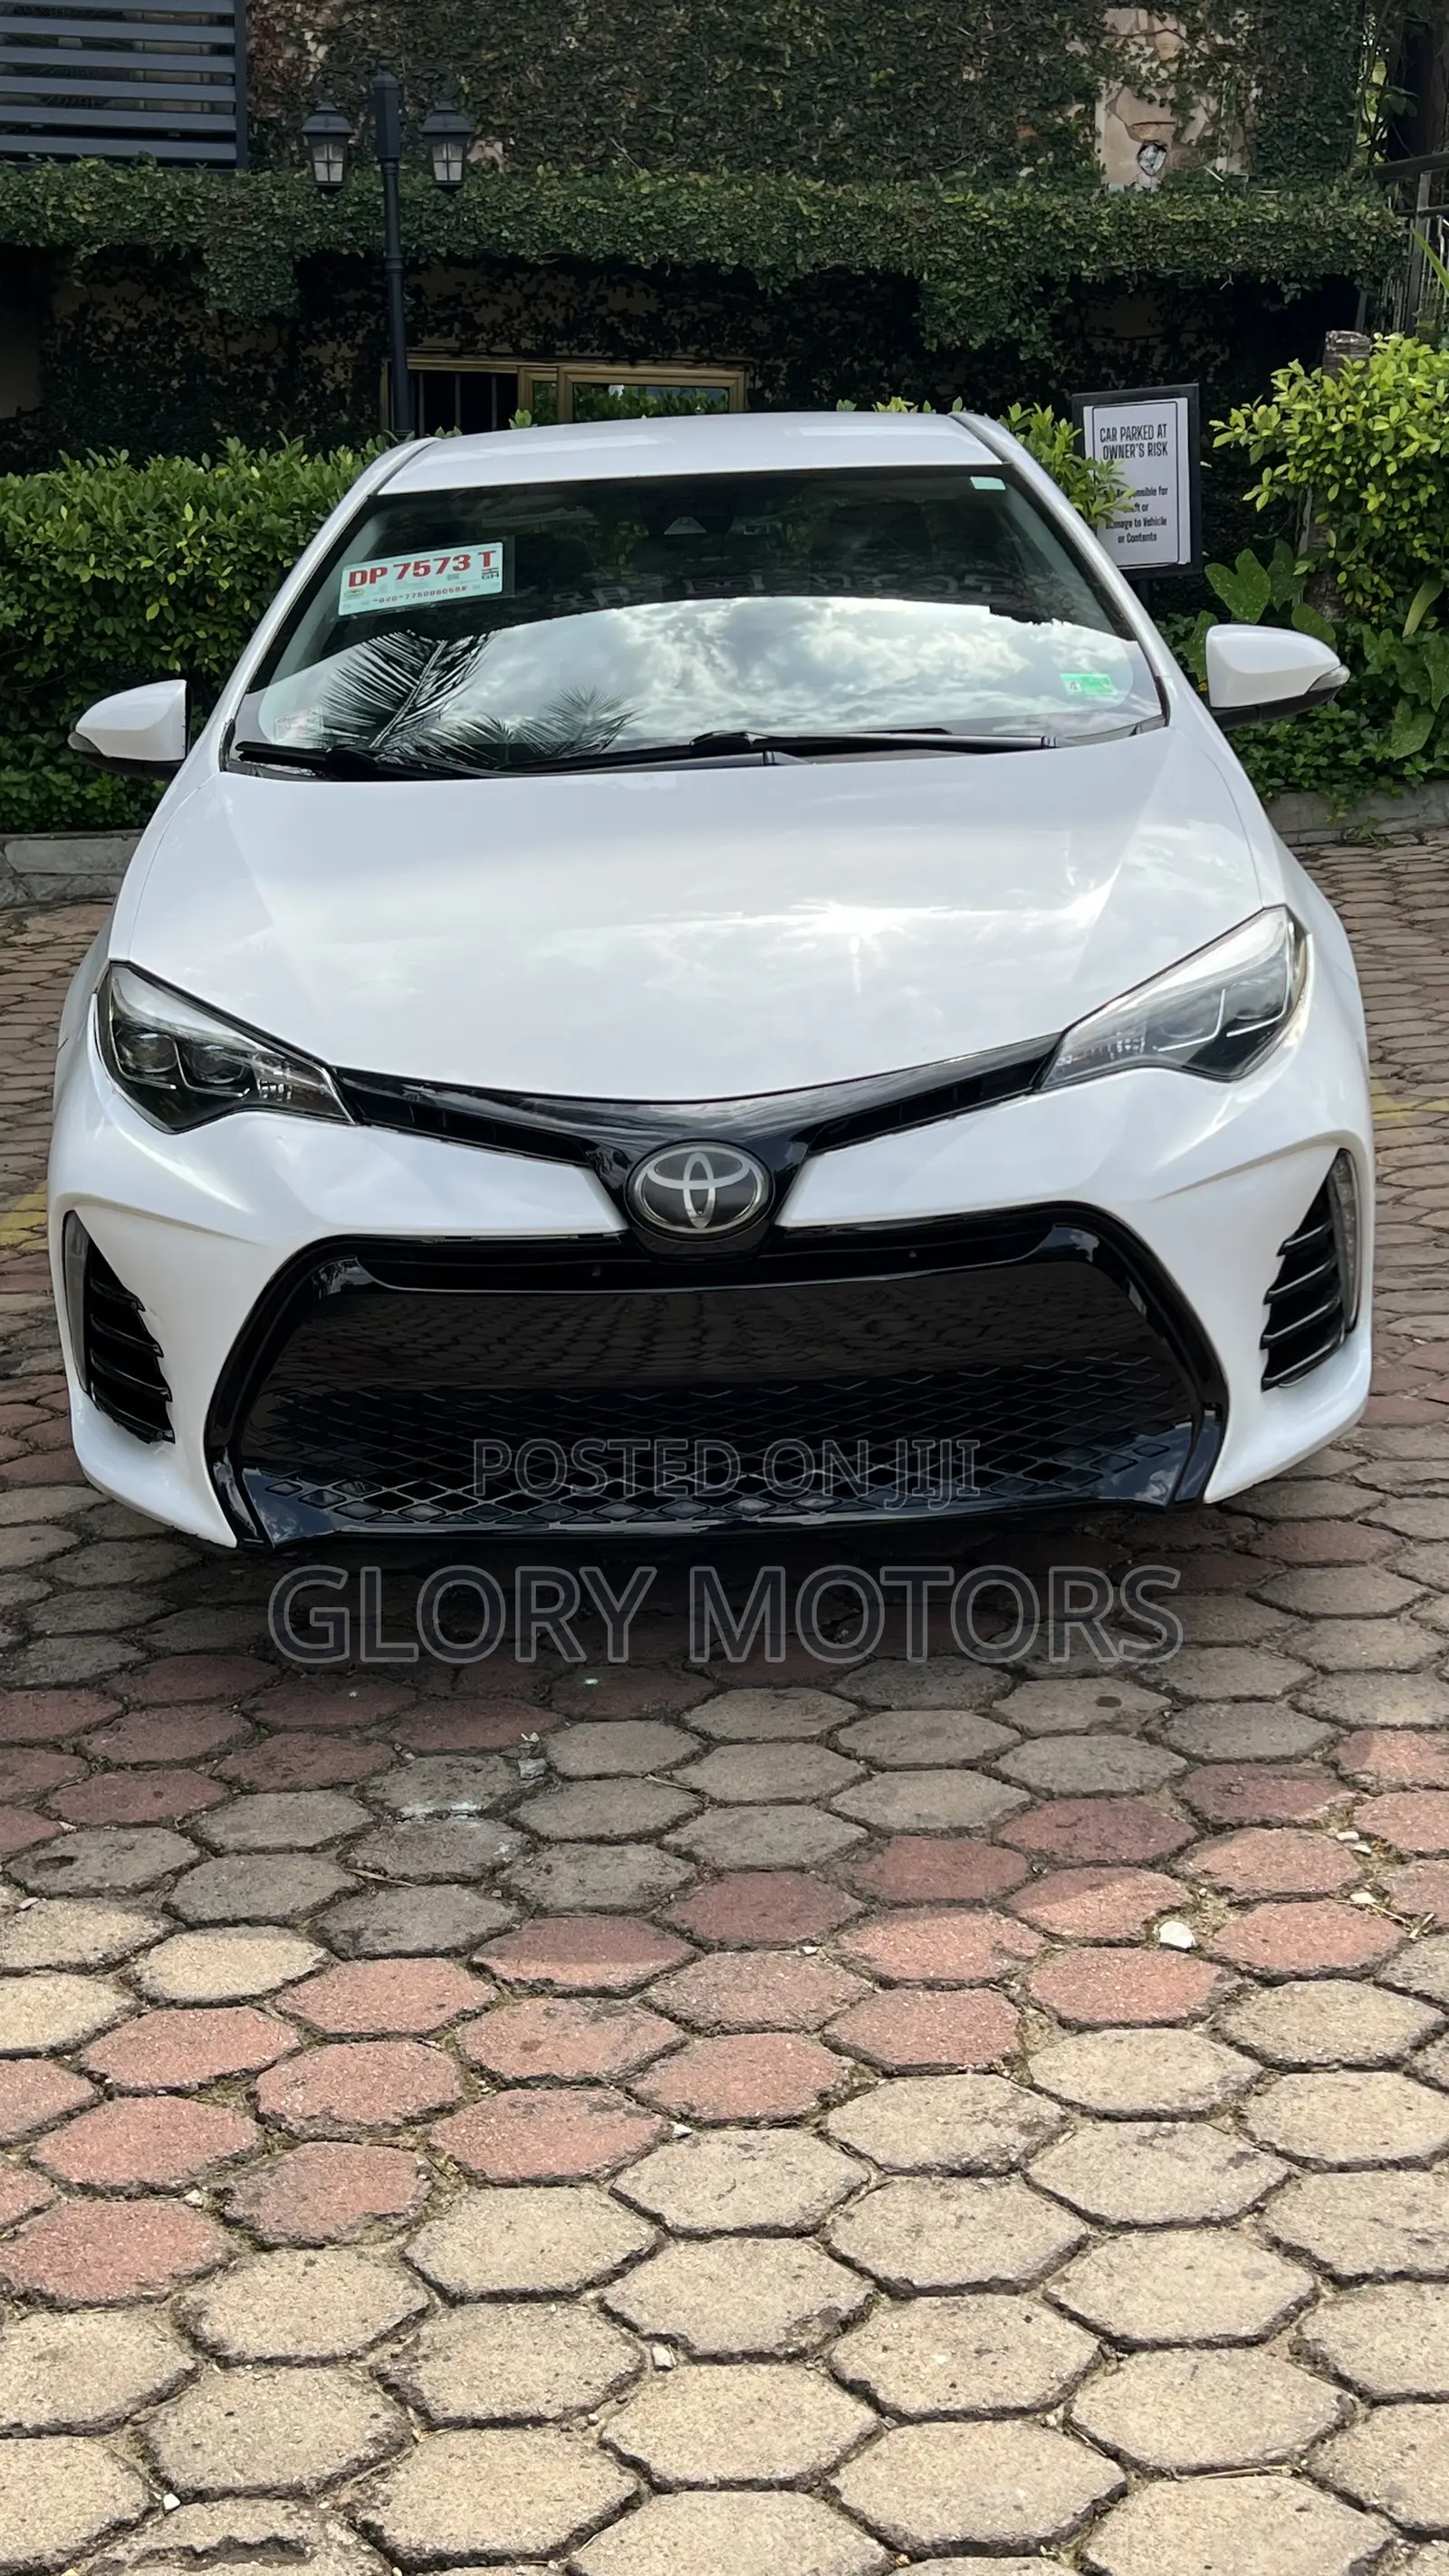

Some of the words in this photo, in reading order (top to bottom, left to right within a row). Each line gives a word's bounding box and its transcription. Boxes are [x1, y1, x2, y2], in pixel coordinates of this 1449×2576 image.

[1099, 426, 1118, 443] CAR
[1120, 424, 1155, 442] PARKED
[1156, 423, 1167, 439] AT
[1102, 443, 1145, 461] OWNER'S
[1147, 441, 1168, 457] RISK
[1158, 485, 1168, 495] for
[1141, 503, 1149, 512] or
[1134, 518, 1142, 527] to
[1143, 516, 1167, 527] Vehicle
[1118, 535, 1125, 543] or
[1127, 532, 1157, 543] Contents
[349, 567, 388, 588] DP
[393, 554, 471, 580] 7573
[477, 550, 497, 568] T
